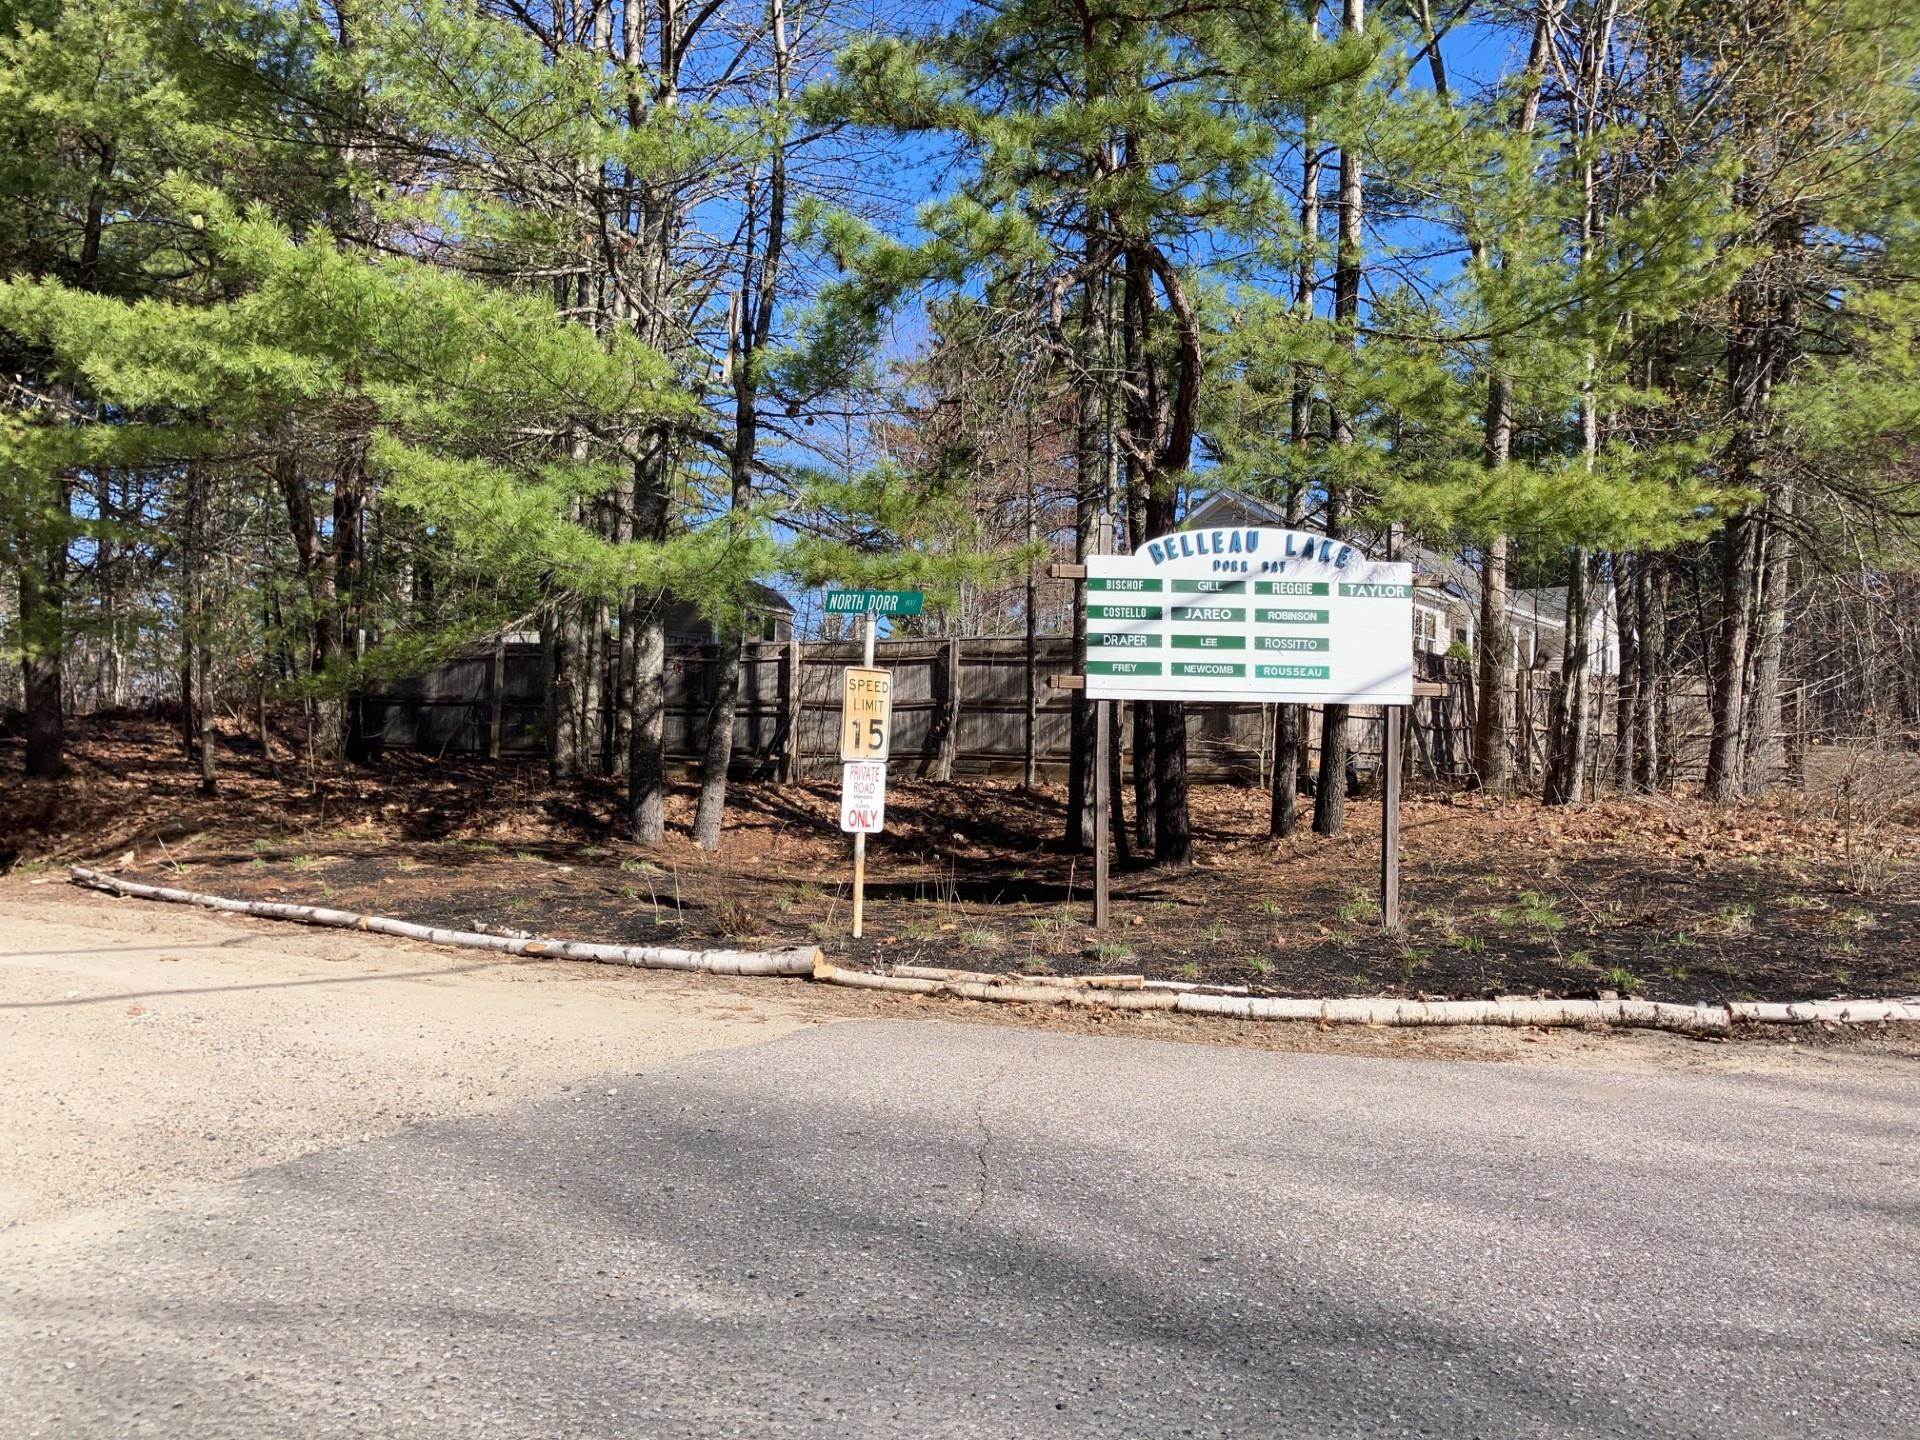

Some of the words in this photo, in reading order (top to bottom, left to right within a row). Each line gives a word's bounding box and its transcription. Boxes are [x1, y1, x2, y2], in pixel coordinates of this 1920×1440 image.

[1147, 530, 1260, 566] BELLEAU
[1285, 533, 1351, 569] LAKE
[1106, 579, 1144, 590] BISCHOF
[1197, 581, 1223, 592] GILL
[1272, 582, 1313, 595] REGGIE
[1347, 584, 1405, 598] TAYLOR
[829, 594, 865, 610] NORTH
[867, 594, 899, 611] DORR
[1103, 606, 1147, 618] COSTELLO
[1185, 608, 1232, 620] JAREO
[1267, 611, 1317, 621] ROBINSON
[1103, 634, 1147, 646] DRAPER
[1200, 638, 1218, 647] LEE
[1264, 638, 1317, 650] ROSSITTO
[1112, 663, 1137, 672] FREY
[1183, 664, 1234, 674] NEWCOMB
[1263, 666, 1322, 677] ROUSSEAU
[849, 678, 889, 694] SPEED
[853, 698, 885, 713] LIMIT
[852, 718, 883, 751] 15
[850, 765, 880, 782] PRIVATE
[853, 782, 876, 794] ROAD
[848, 809, 878, 829] ONLY
